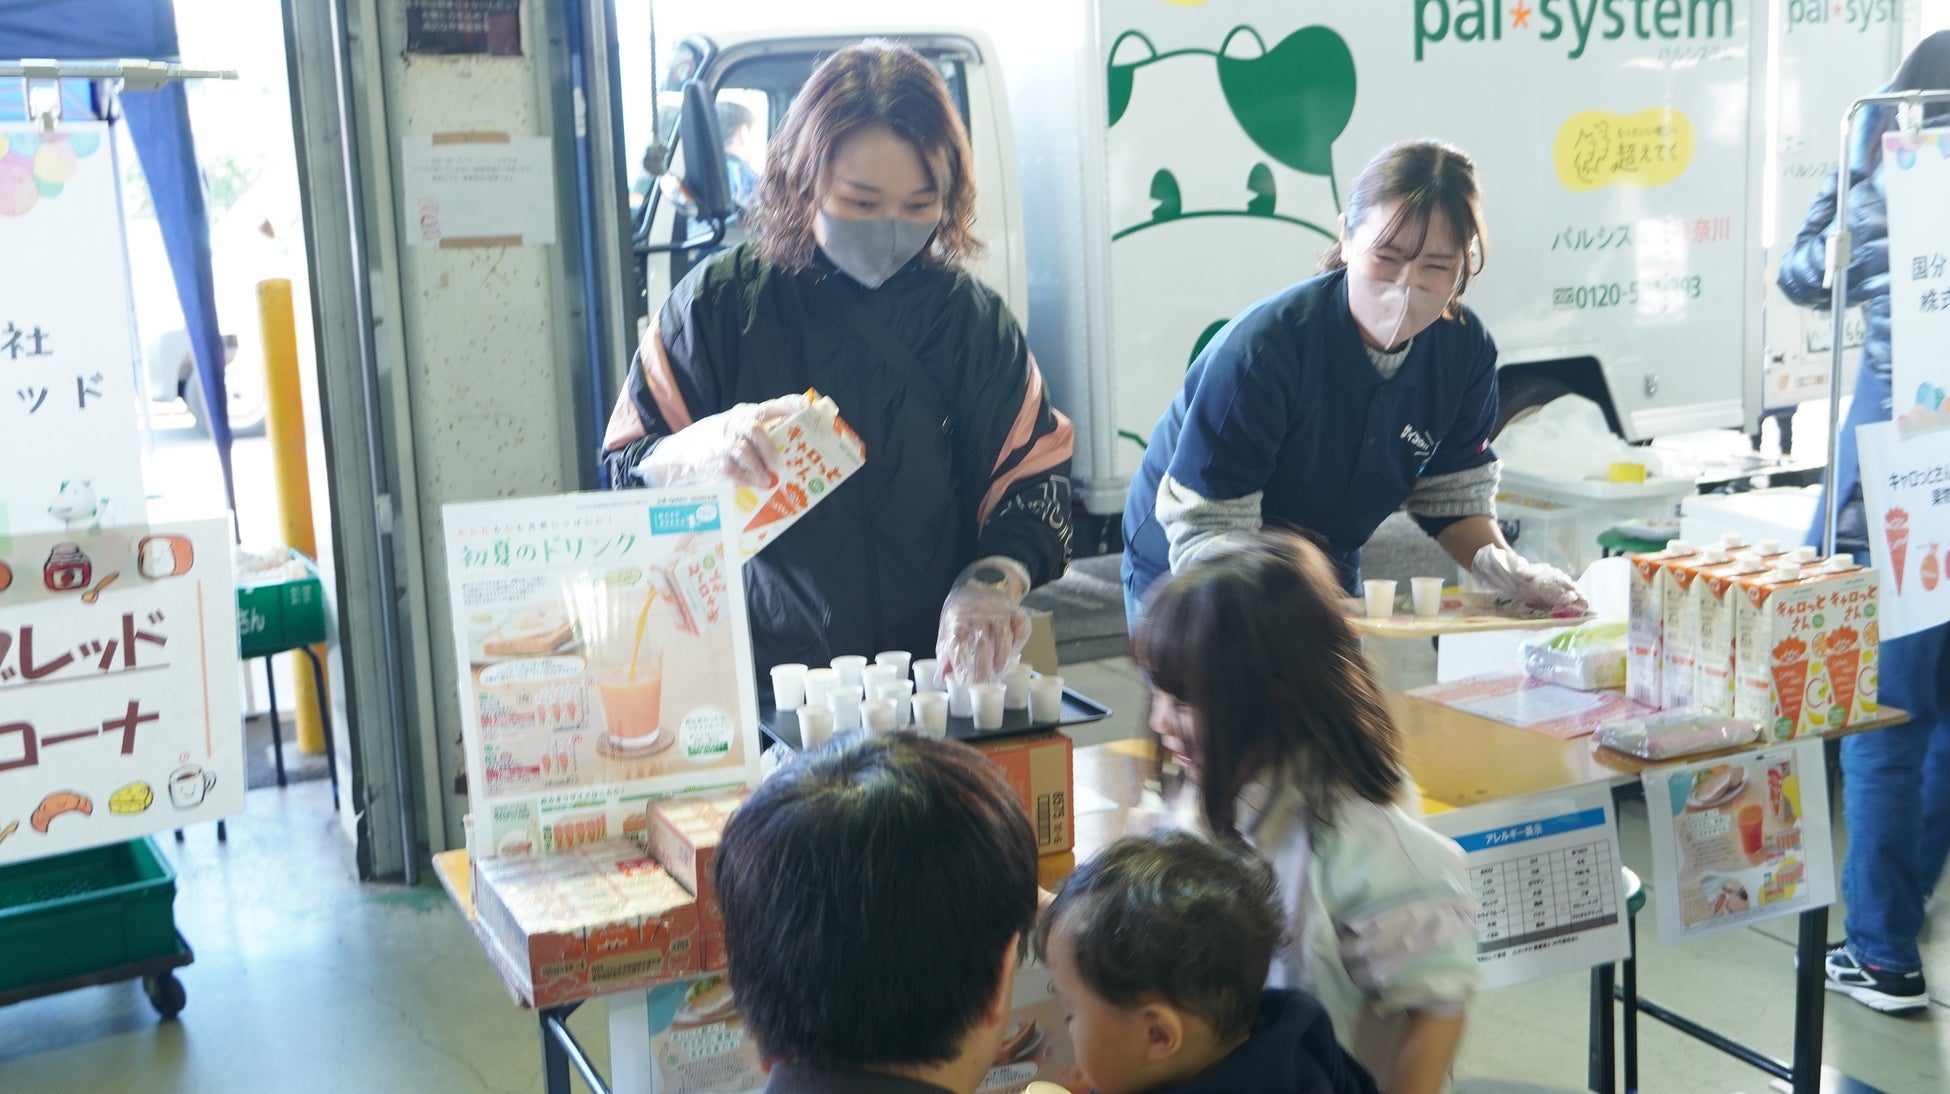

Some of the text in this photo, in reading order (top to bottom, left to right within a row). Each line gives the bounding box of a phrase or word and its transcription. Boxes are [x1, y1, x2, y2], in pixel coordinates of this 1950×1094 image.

[1610, 141, 1678, 173] 超えてく
[1912, 252, 1948, 281] 国分
[0, 321, 53, 360] 社
[462, 532, 636, 569] 初夏のドリンク
[1484, 823, 1544, 845] アレルギー表示
